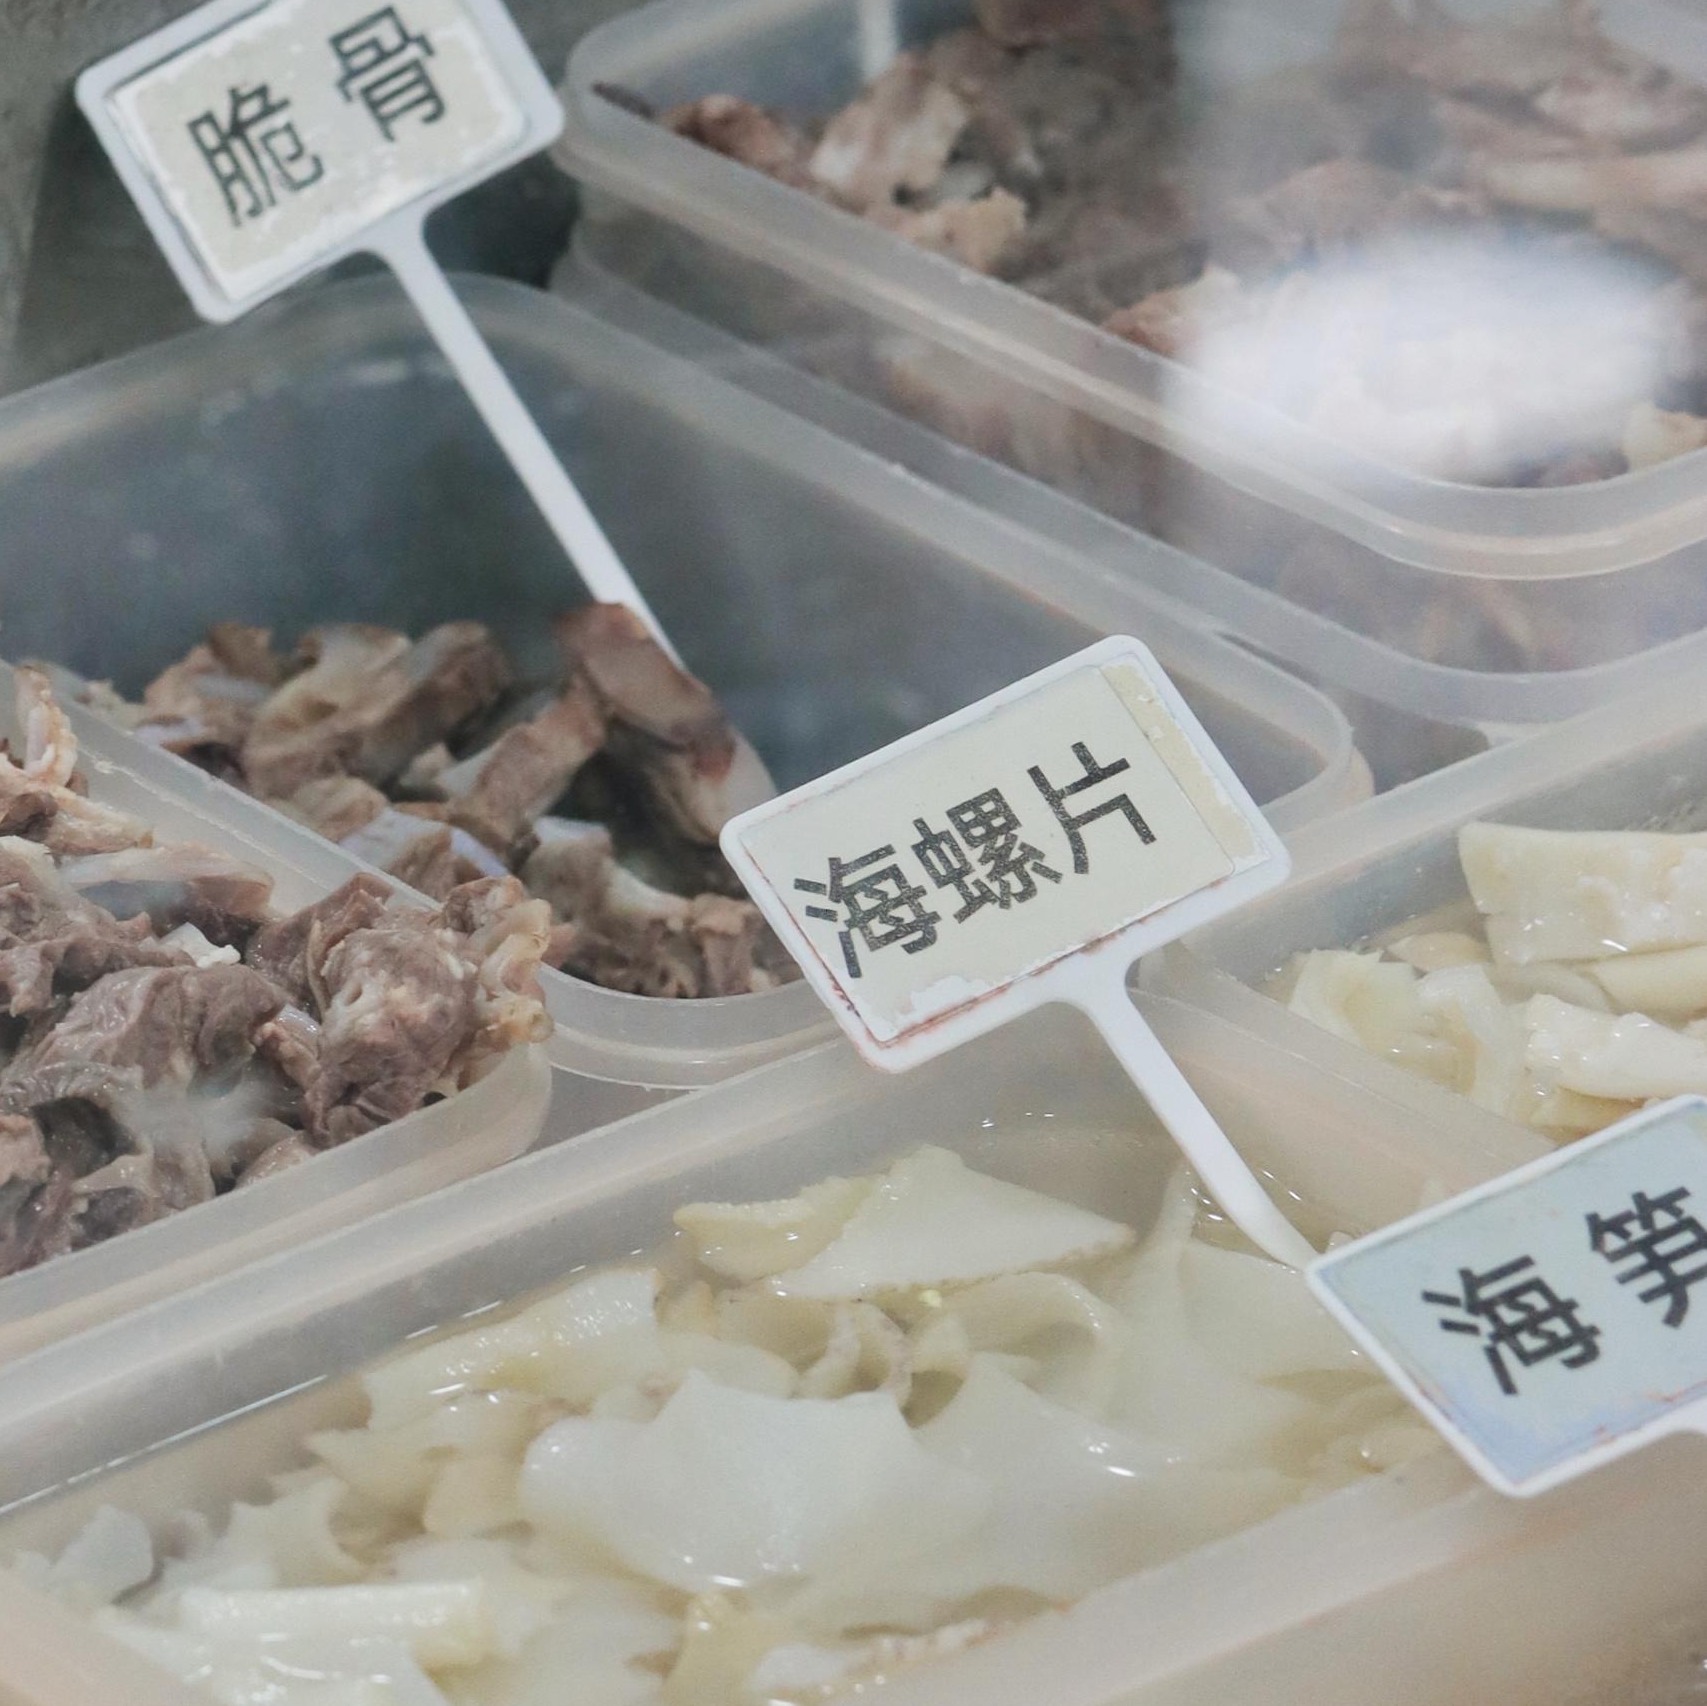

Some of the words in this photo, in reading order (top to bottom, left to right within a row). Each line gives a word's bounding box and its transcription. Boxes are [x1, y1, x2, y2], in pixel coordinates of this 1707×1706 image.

[186, 5, 445, 227] 脆骨
[794, 741, 1156, 978] 海螺片
[1421, 1186, 1707, 1395] 海笋
